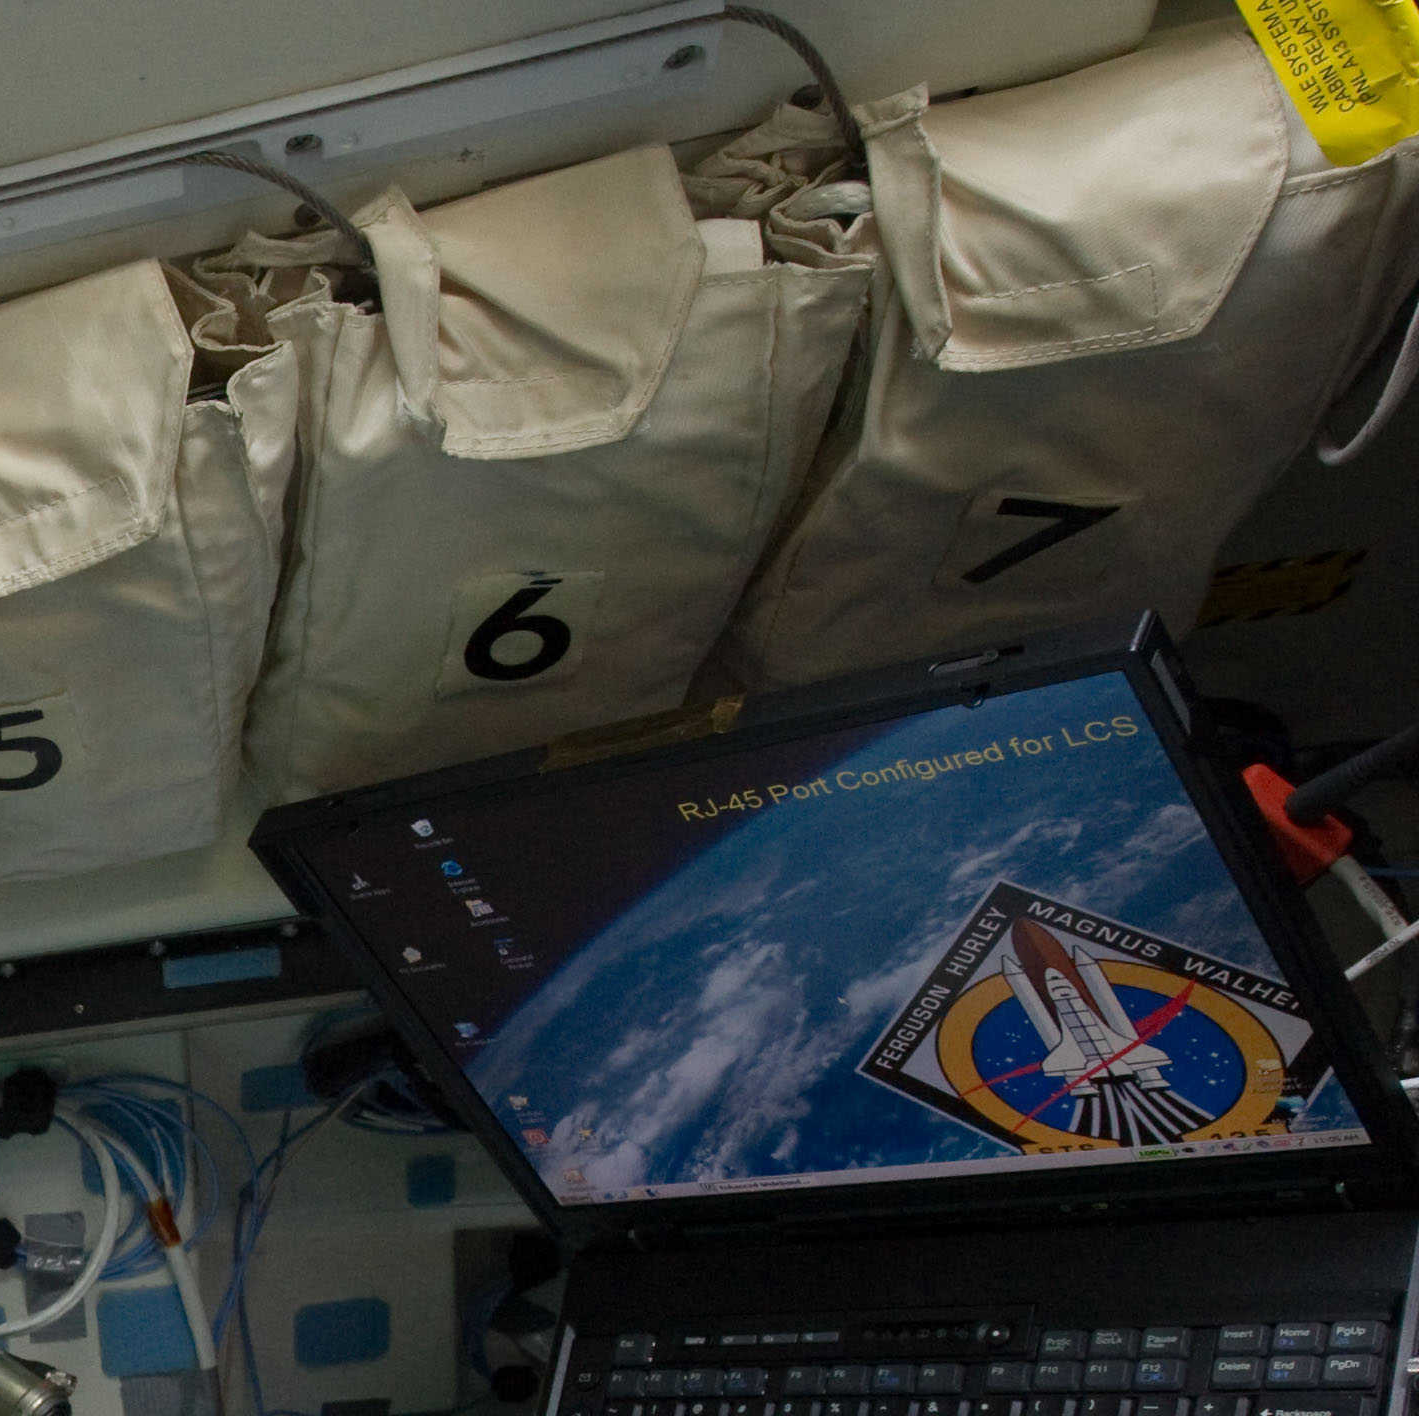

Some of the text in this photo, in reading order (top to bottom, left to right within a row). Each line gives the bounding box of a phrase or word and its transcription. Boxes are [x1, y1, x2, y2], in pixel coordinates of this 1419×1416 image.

[1261, 11, 1330, 114] WLE SYSTEM
[1289, 13, 1357, 114] CABIN RELAY
[961, 496, 1121, 583] 7
[463, 586, 573, 680] 6
[676, 716, 1139, 822] RJ-45 Port Configured for LCS
[1027, 900, 1162, 959] MAGNUS
[877, 906, 1008, 1071] FERGUSON HURLEY
[1223, 1329, 1255, 1339] Insert
[1279, 1328, 1311, 1338] Home
[1336, 1326, 1366, 1338] PgUp
[1218, 1362, 1251, 1372] Delete
[1273, 1361, 1295, 1371] End
[1330, 1359, 1360, 1371] PgDn
